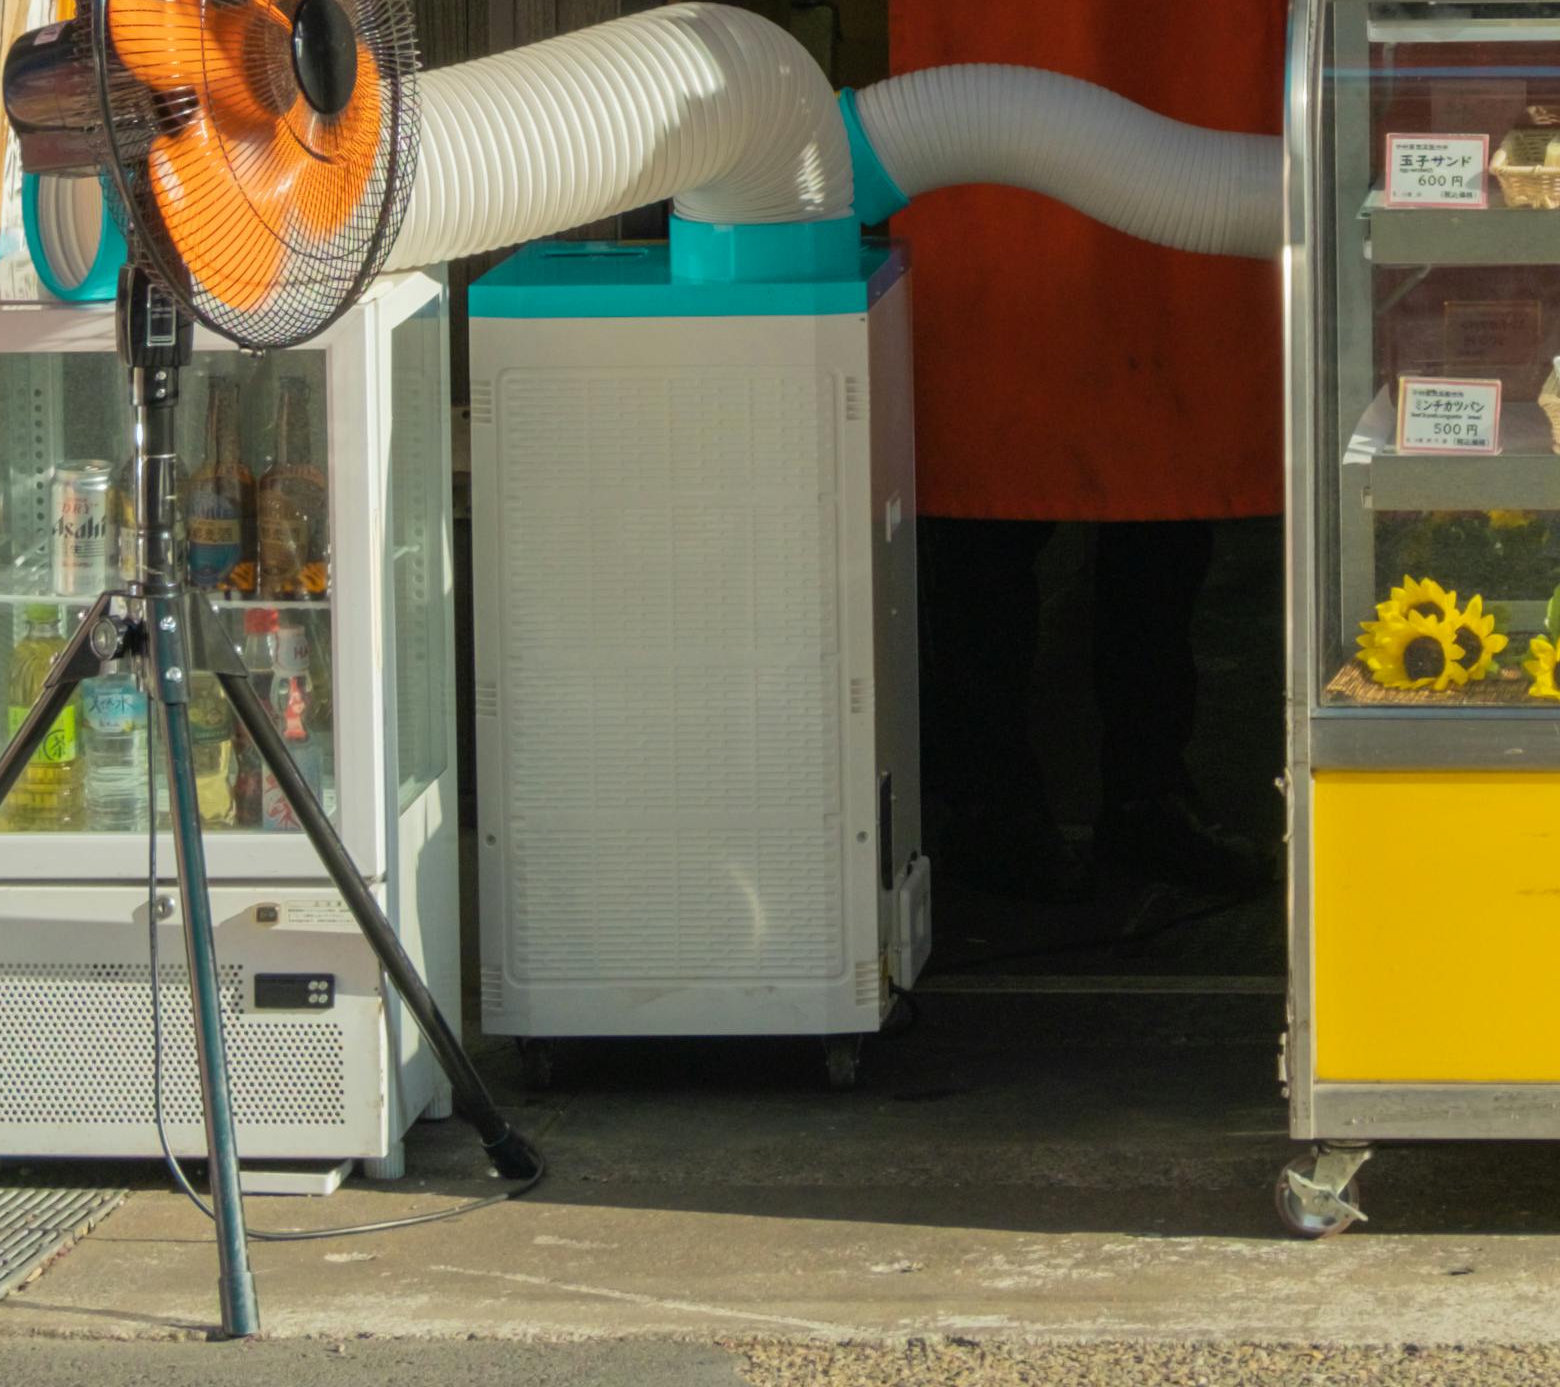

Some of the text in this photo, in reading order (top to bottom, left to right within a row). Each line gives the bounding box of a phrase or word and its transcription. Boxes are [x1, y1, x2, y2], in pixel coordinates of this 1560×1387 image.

[1400, 153, 1474, 168] 玉子サンド
[1417, 173, 1465, 188] 600円
[1413, 398, 1486, 414] ミンチカツパン
[1433, 422, 1479, 437] 500円
[51, 515, 106, 539] Asahi
